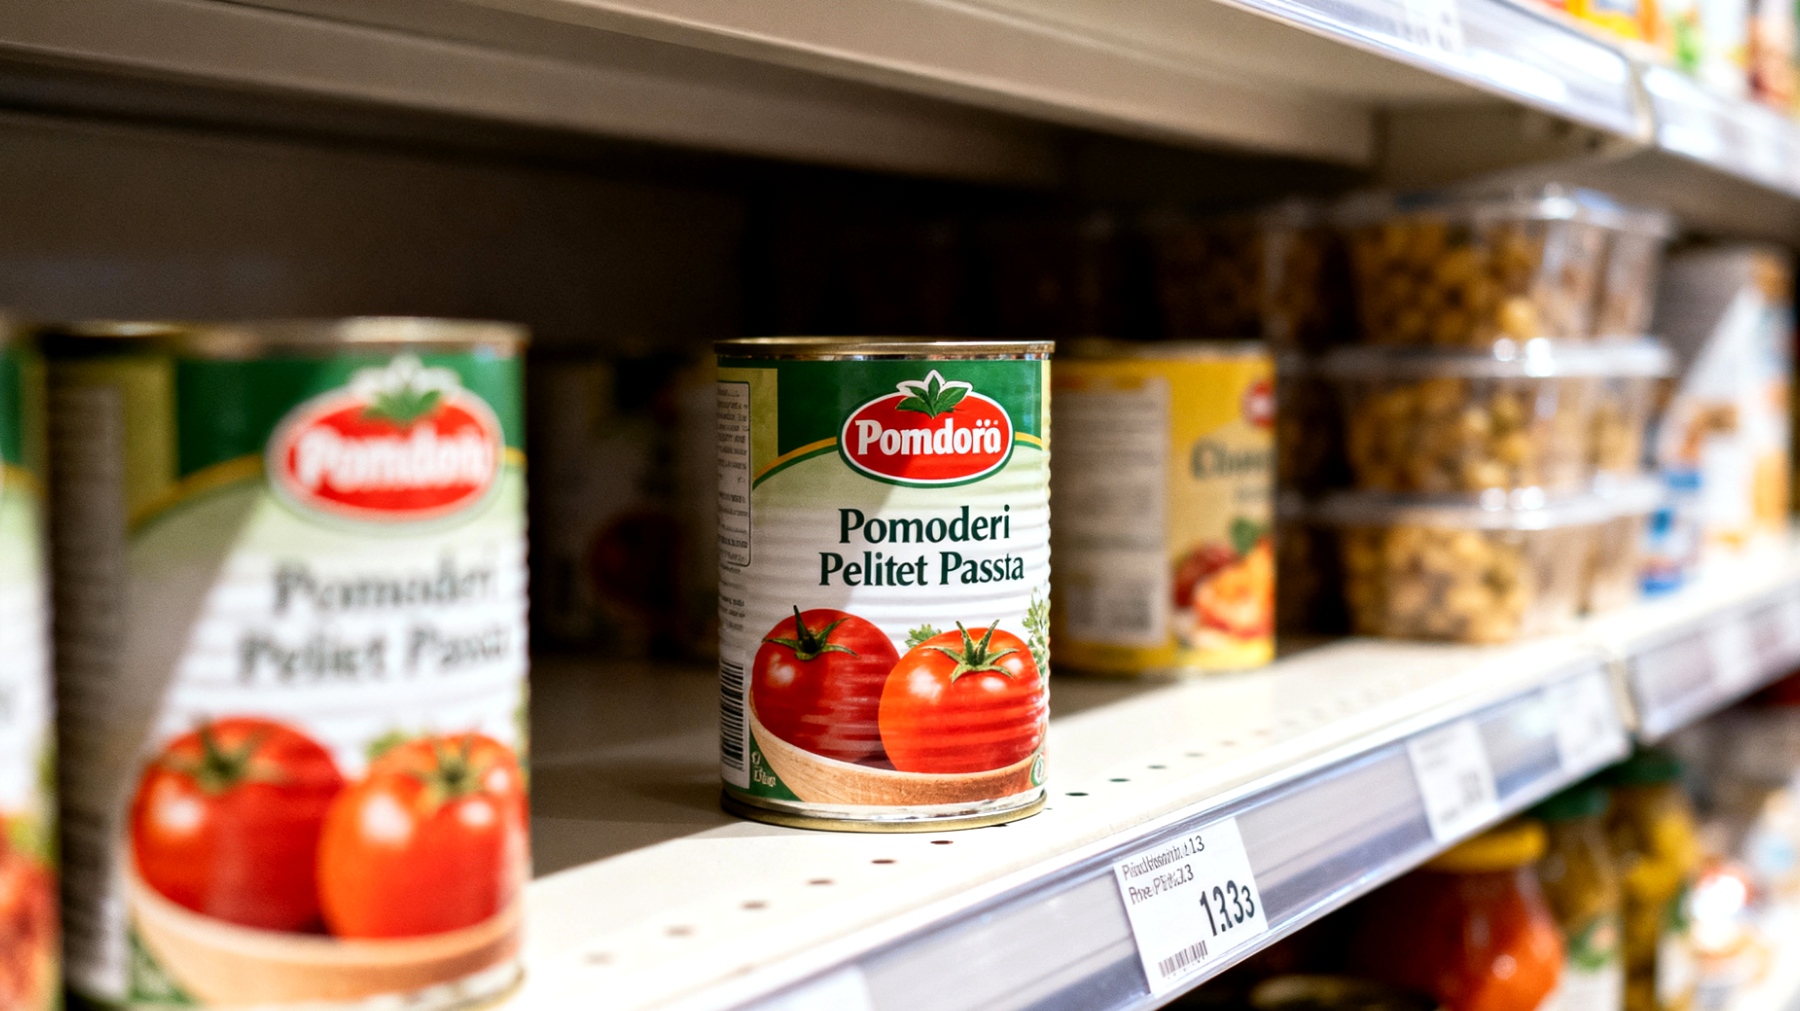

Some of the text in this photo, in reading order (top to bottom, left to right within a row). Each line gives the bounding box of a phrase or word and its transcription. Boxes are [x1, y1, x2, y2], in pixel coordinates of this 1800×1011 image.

[838, 505, 1010, 544] Pomoderi
[819, 551, 1025, 587] Pelitet Passta
